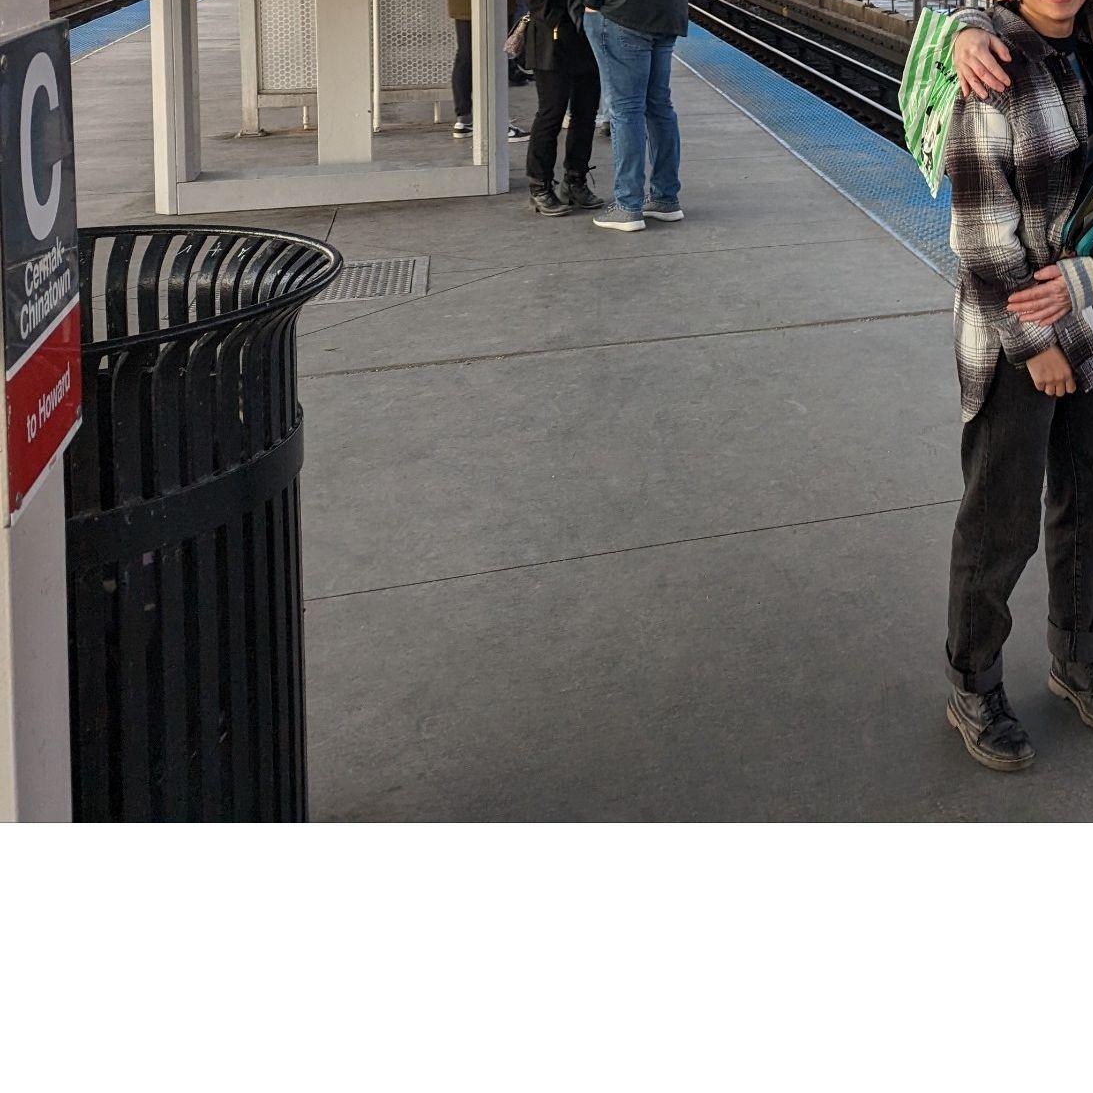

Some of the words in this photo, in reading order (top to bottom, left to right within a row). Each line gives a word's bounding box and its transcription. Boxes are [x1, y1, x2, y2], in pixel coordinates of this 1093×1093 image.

[20, 51, 62, 241] C
[20, 267, 71, 340] Chinatown
[24, 242, 65, 297] Cermak-
[26, 413, 37, 443] to
[38, 360, 71, 429] Howard
